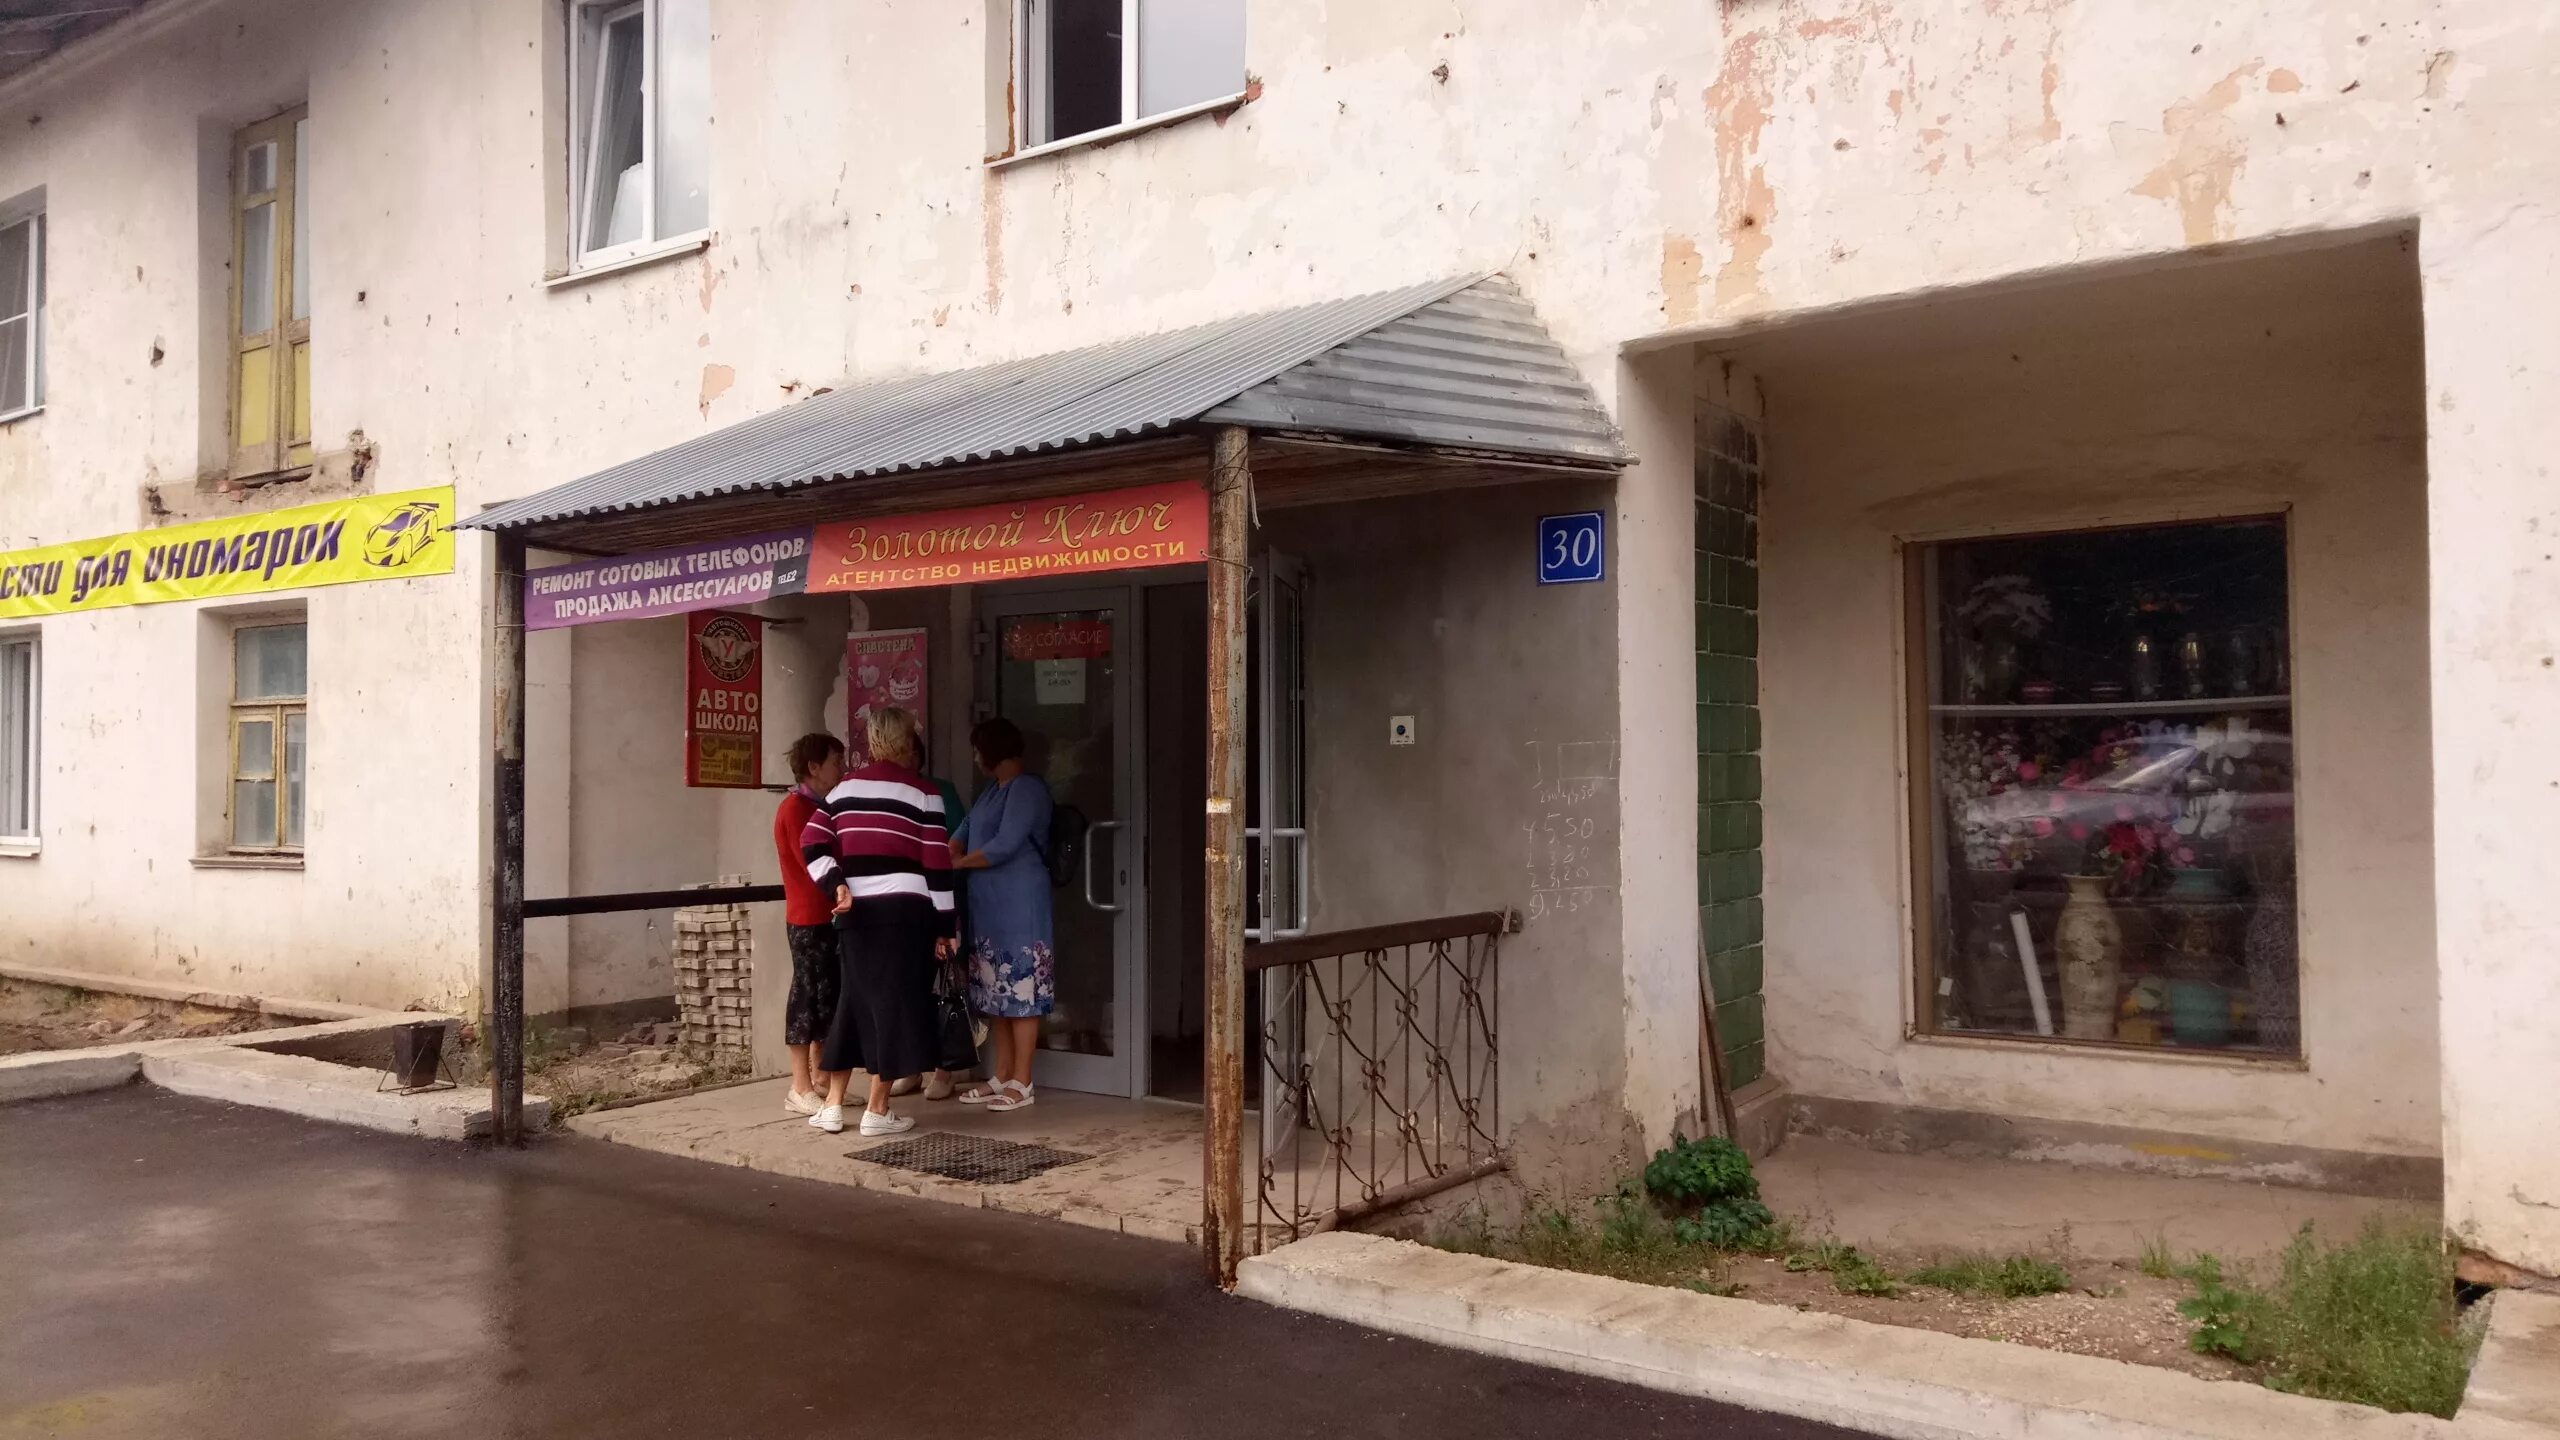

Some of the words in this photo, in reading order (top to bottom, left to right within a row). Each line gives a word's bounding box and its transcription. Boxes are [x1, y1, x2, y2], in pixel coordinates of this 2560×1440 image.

[840, 505, 1027, 567] Золотой
[1037, 499, 1175, 549] Ключ
[1546, 527, 1596, 569] 30
[0, 560, 63, 599] сти
[70, 549, 132, 603] для
[143, 519, 347, 583] иномарок
[532, 570, 596, 596] РЕМОНТ
[599, 556, 682, 585] СОТОВЫХ
[686, 537, 806, 570] ТЕЛЕФОНОВ
[777, 569, 798, 585] TELE2
[825, 563, 962, 586] АГЕНТСТВО
[972, 541, 1186, 576] НЕДВИЖИМОСТИ
[555, 590, 643, 619] ПРОДАЖА
[646, 570, 774, 606] АКСЕССУАРОВ
[1036, 629, 1104, 647] СОГЛАСИЕ
[695, 711, 760, 733] ШКОЛА
[696, 688, 759, 713] АВТО
